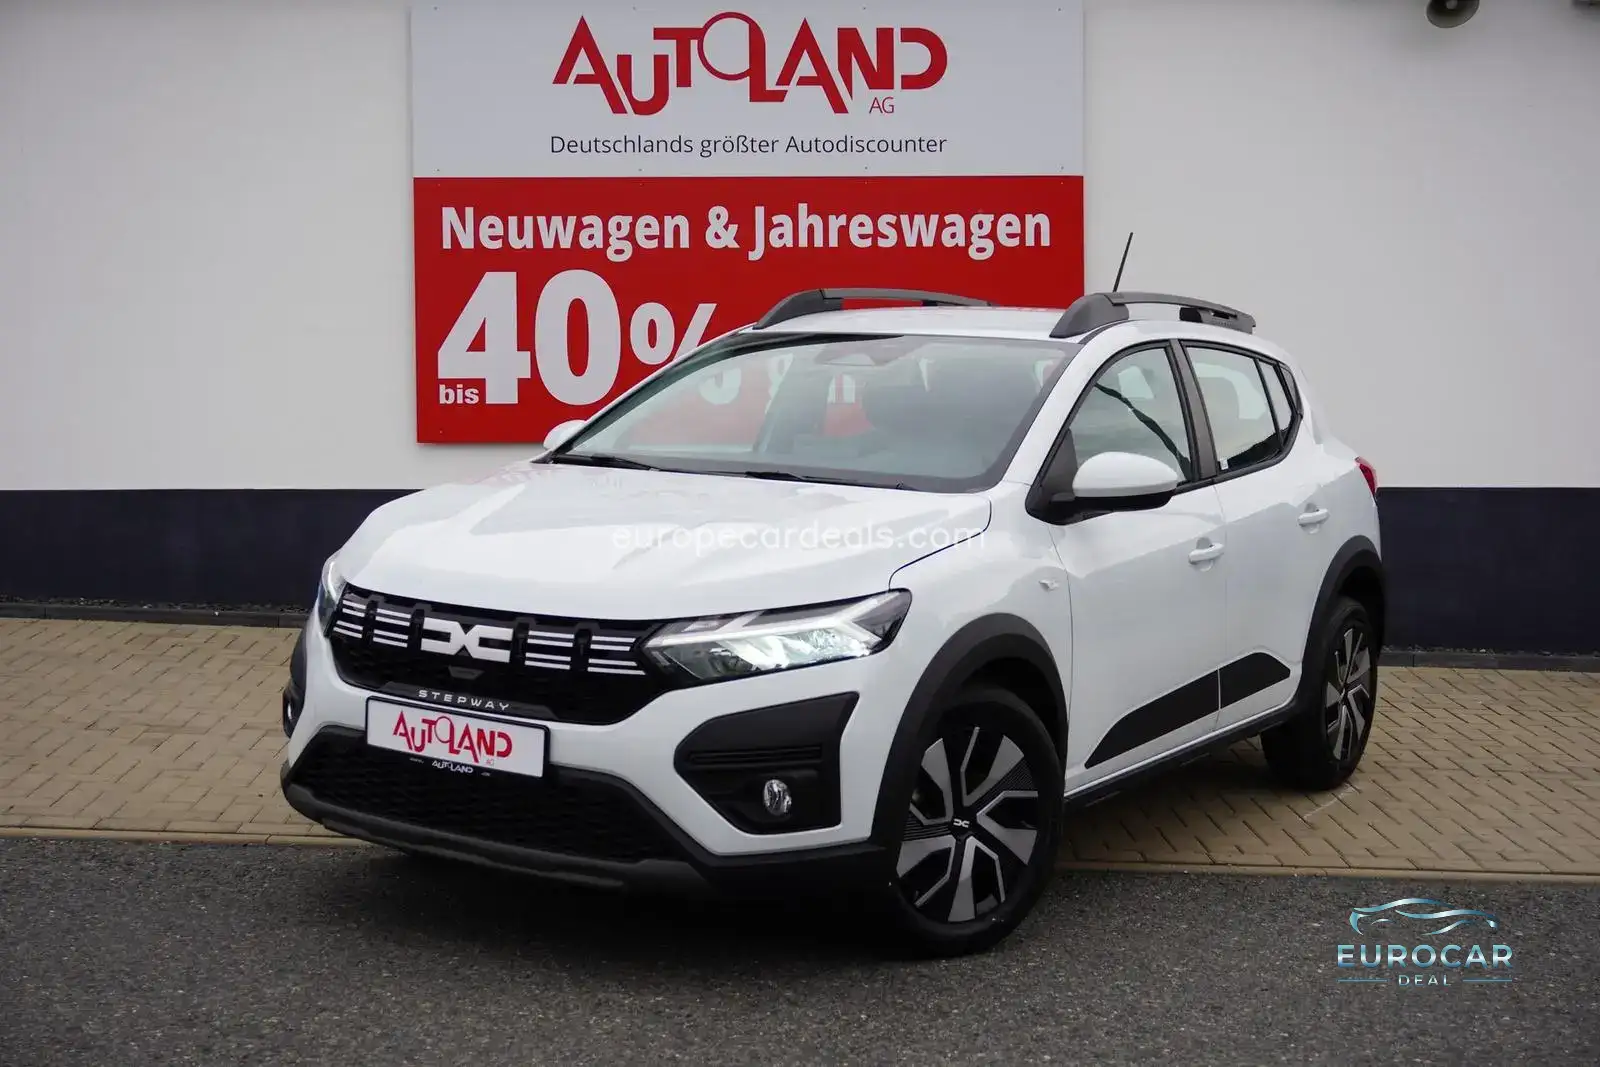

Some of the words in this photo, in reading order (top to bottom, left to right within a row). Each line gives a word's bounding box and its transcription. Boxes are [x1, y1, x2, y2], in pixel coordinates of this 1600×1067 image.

[552, 11, 948, 116] AUTOLAND
[869, 96, 895, 114] AG
[550, 136, 693, 153] Deutschlands
[699, 136, 779, 158] größter
[785, 136, 947, 154] Autodiscounter
[441, 206, 690, 262] Neuwagen
[705, 205, 738, 248] &
[748, 203, 1051, 262] Jahreswagen
[438, 384, 479, 405] bis
[418, 689, 510, 711] STEPWAY
